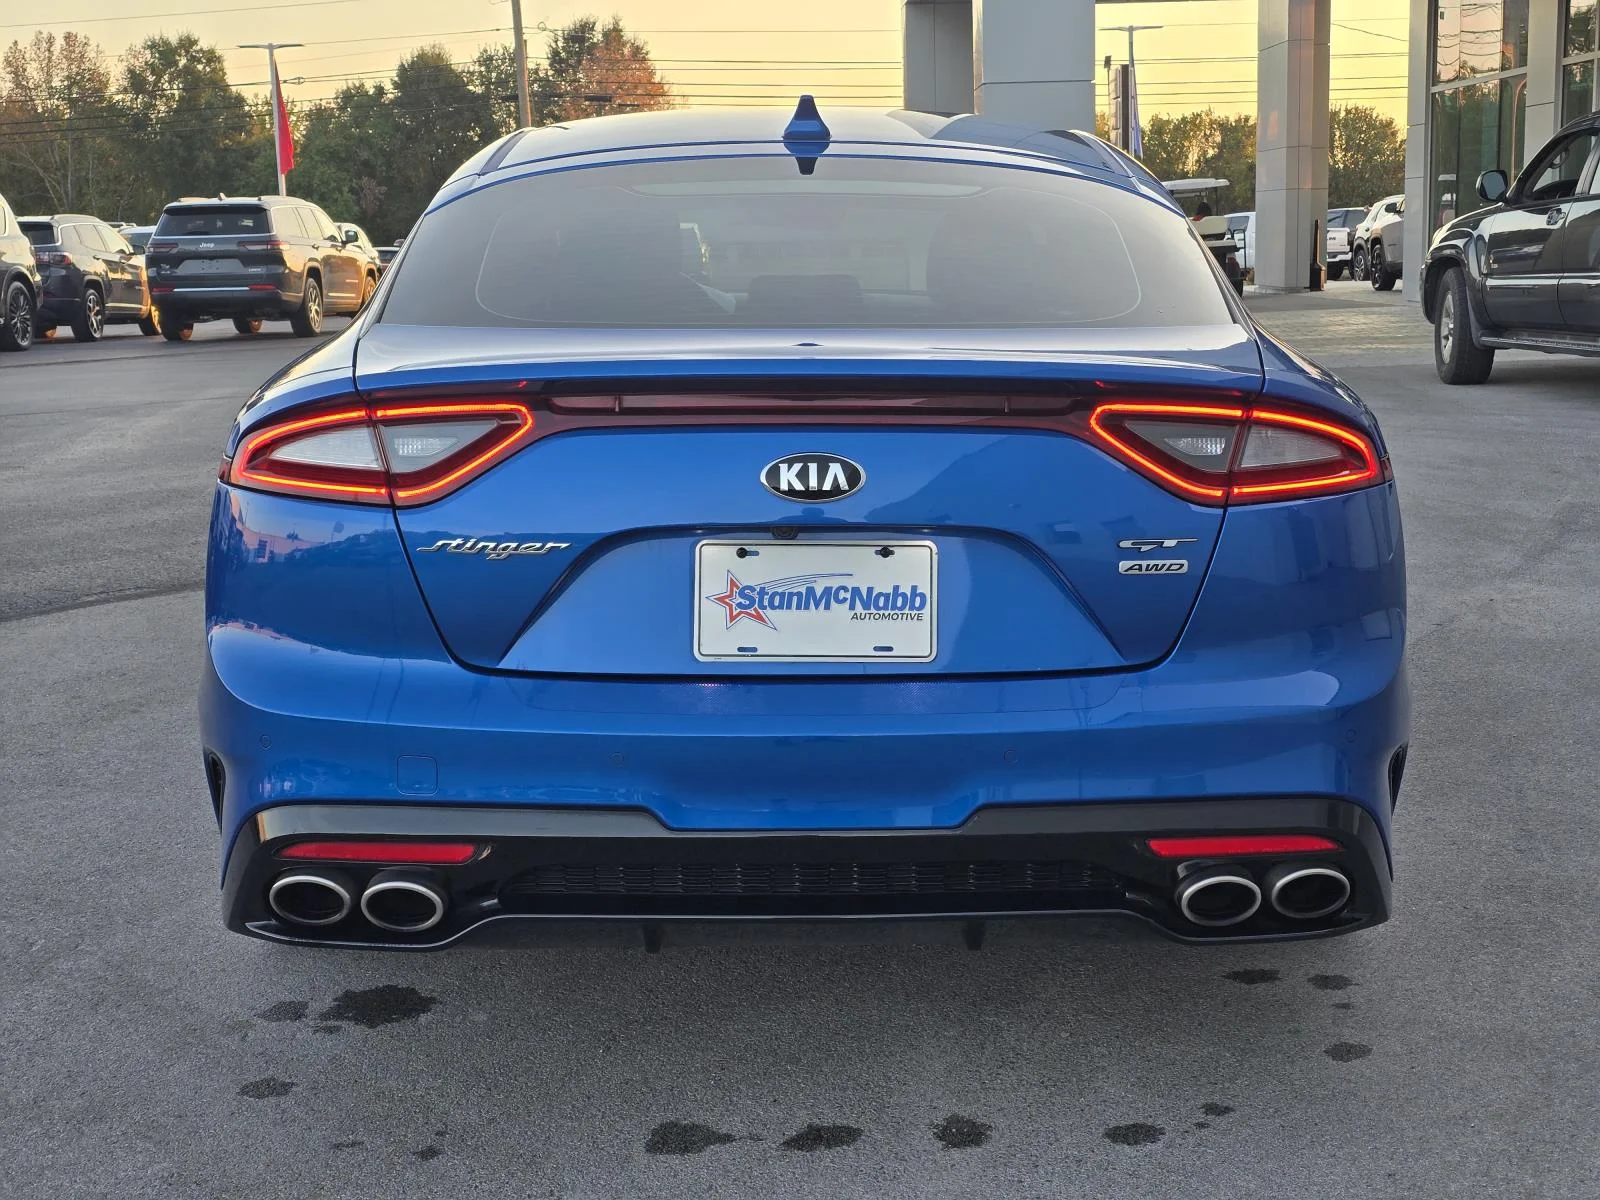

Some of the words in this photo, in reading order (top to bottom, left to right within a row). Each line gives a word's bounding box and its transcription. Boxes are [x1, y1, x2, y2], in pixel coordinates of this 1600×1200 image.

[778, 462, 850, 491] KIA
[1118, 538, 1199, 552] GT
[1123, 563, 1185, 573] AWD
[850, 612, 924, 621] AUTOMOTIVE
